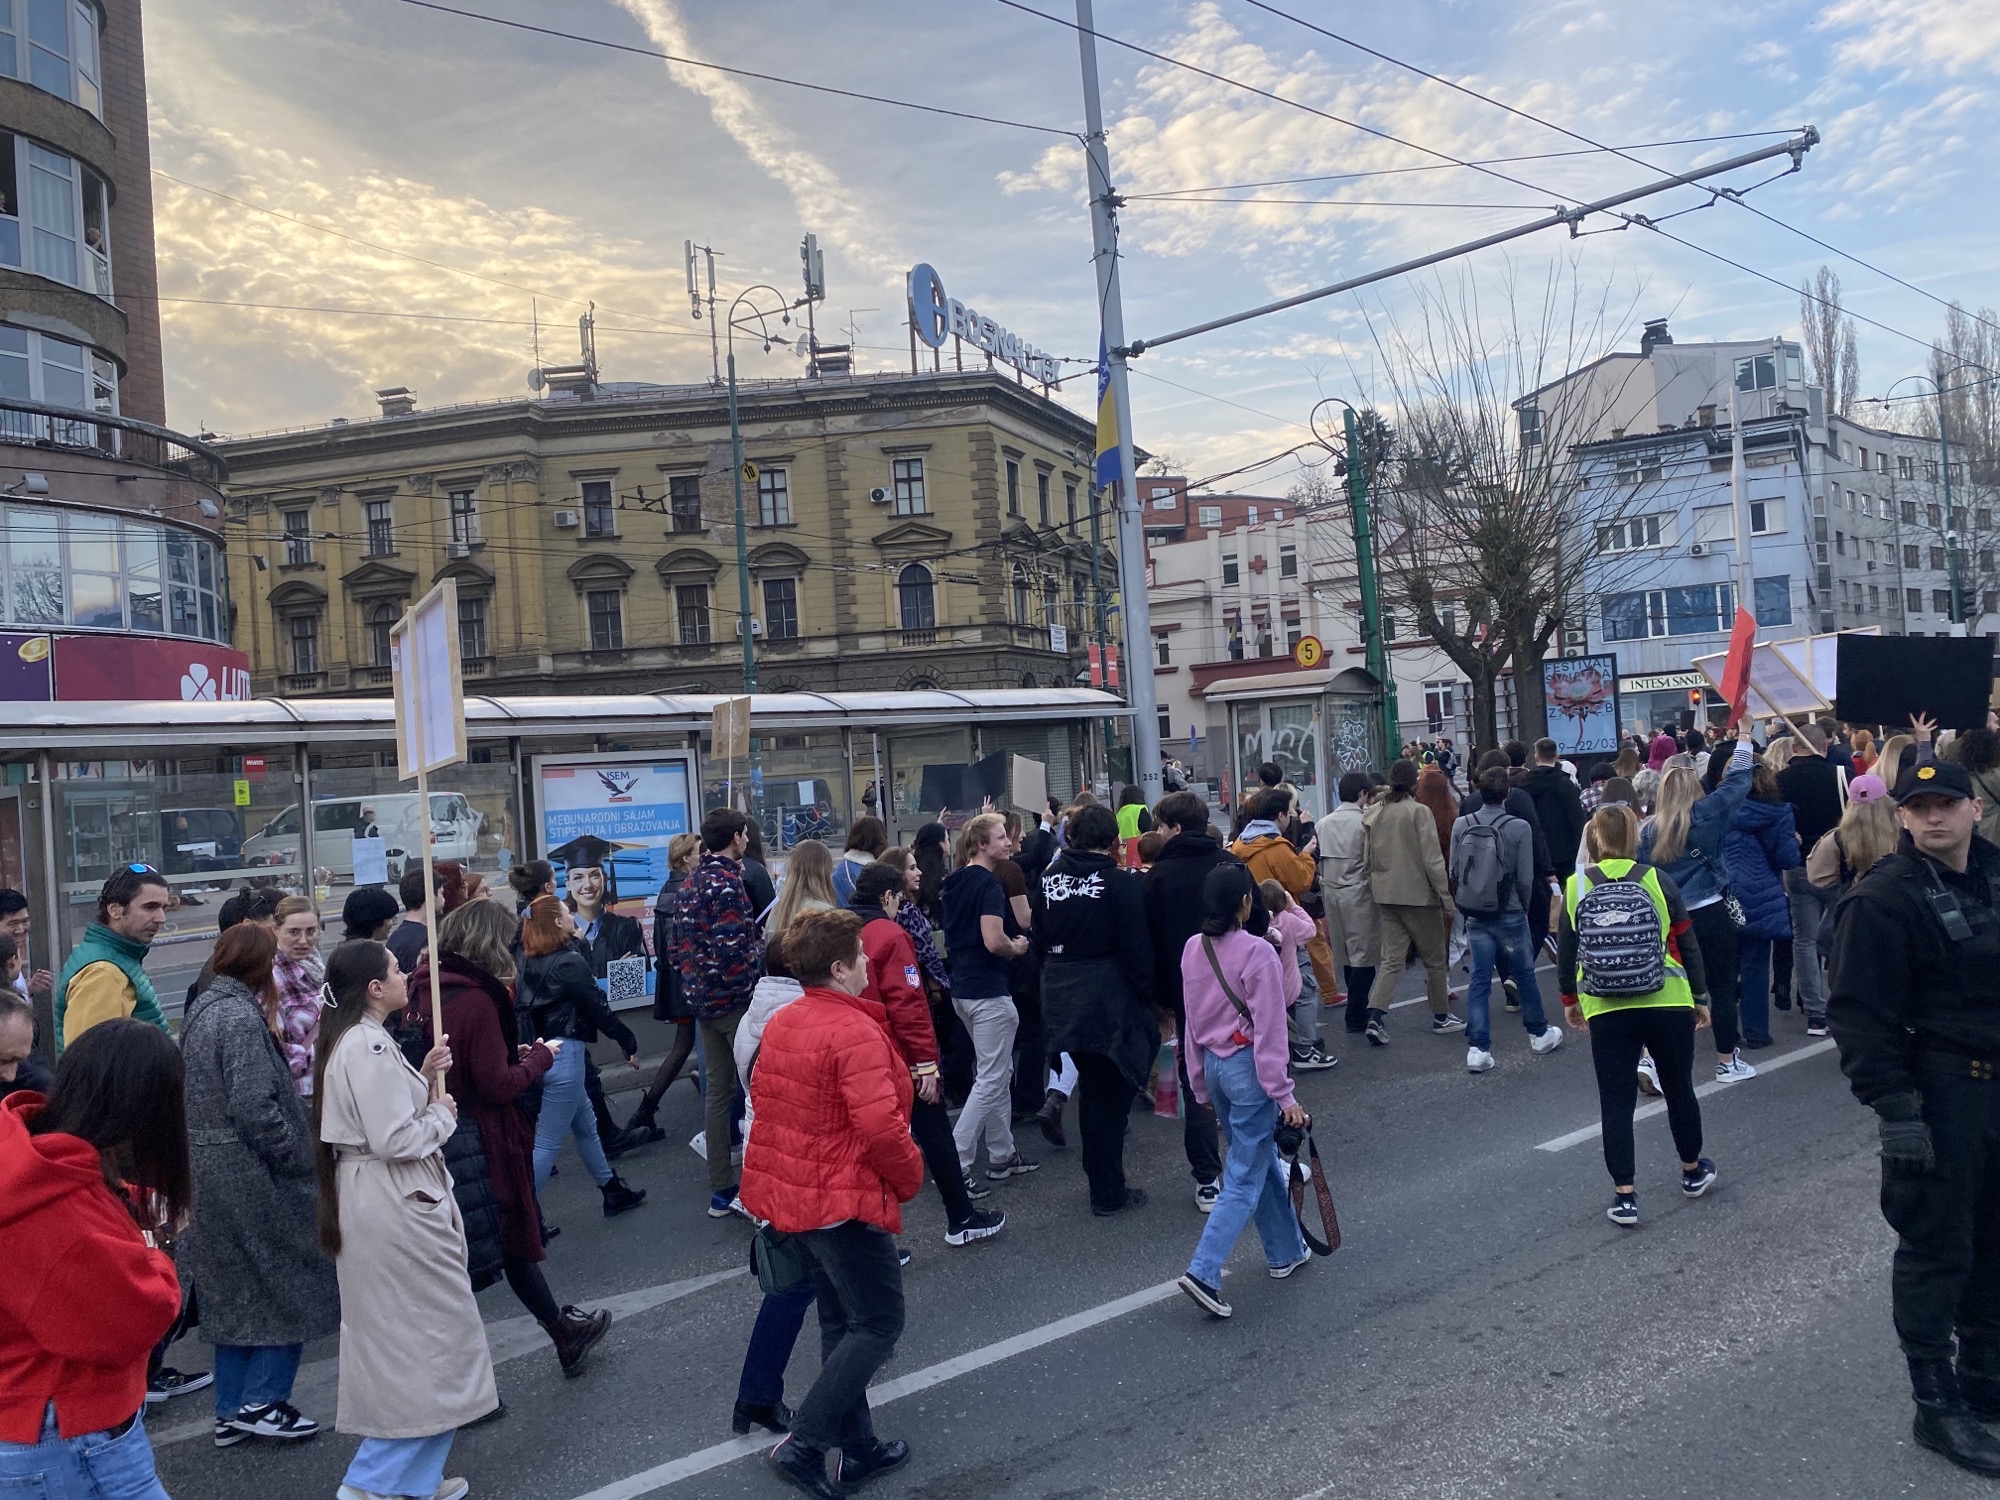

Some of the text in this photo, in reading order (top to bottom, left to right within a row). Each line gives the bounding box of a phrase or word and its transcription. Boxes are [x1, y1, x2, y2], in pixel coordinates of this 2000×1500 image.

[744, 463, 756, 479] 10
[1305, 643, 1313, 660] 5
[1545, 657, 1611, 674] FESTIVAL
[1630, 677, 1670, 690] INTESA
[1142, 772, 1158, 782] 252
[548, 809, 655, 826] MEĐUNARODNI SAJAM
[549, 825, 606, 839] STIPENDIJA
[614, 819, 681, 834] OBRAZOVANJA
